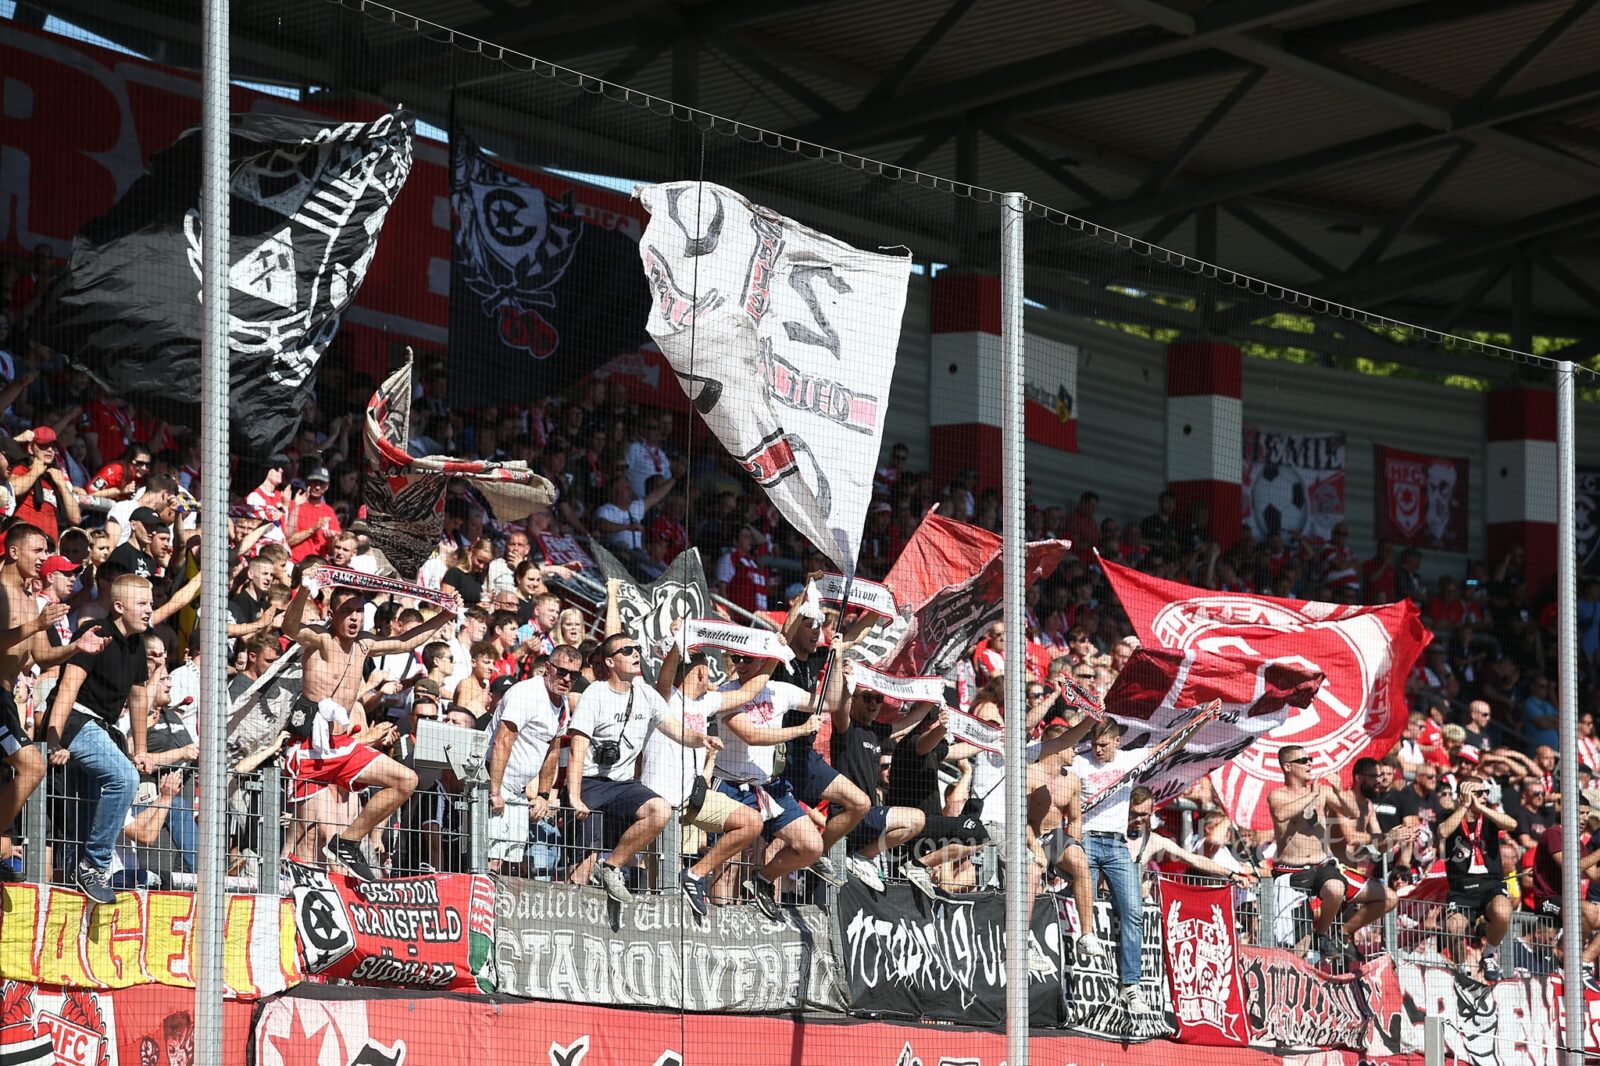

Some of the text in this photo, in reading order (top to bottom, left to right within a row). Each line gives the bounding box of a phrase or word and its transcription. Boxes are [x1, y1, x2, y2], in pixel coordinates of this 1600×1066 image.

[828, 581, 878, 602] Saefront
[696, 627, 749, 646] Saalefront
[350, 905, 462, 942] MANSFELD
[352, 946, 458, 985] SÜDHARZ
[50, 1022, 89, 1061] HFC
